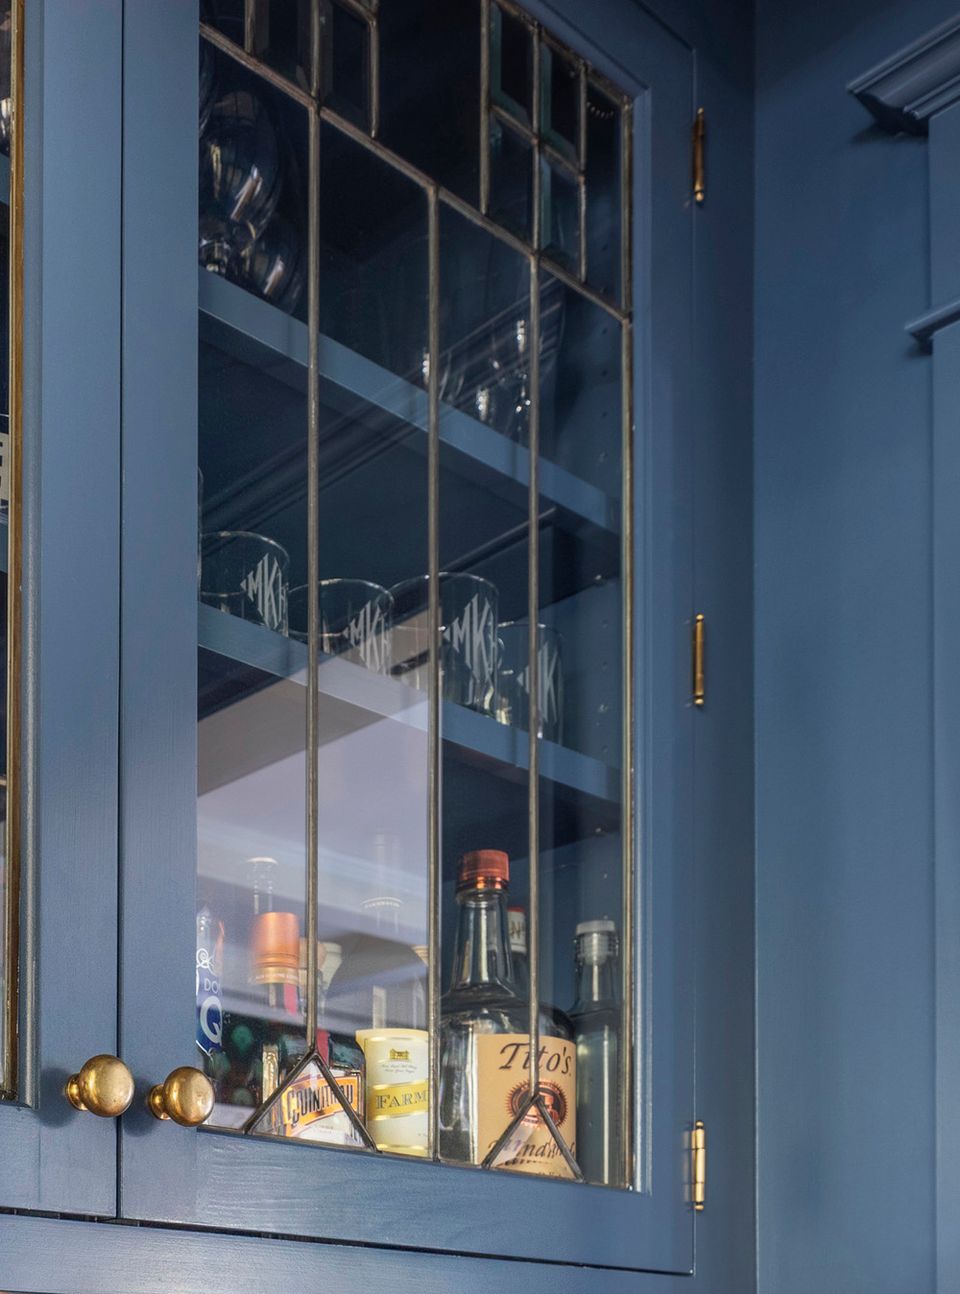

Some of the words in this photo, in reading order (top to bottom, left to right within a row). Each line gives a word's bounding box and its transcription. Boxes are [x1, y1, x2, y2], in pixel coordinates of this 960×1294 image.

[203, 978, 222, 994] DO
[199, 997, 222, 1044] Q
[498, 1042, 572, 1076] Tto's
